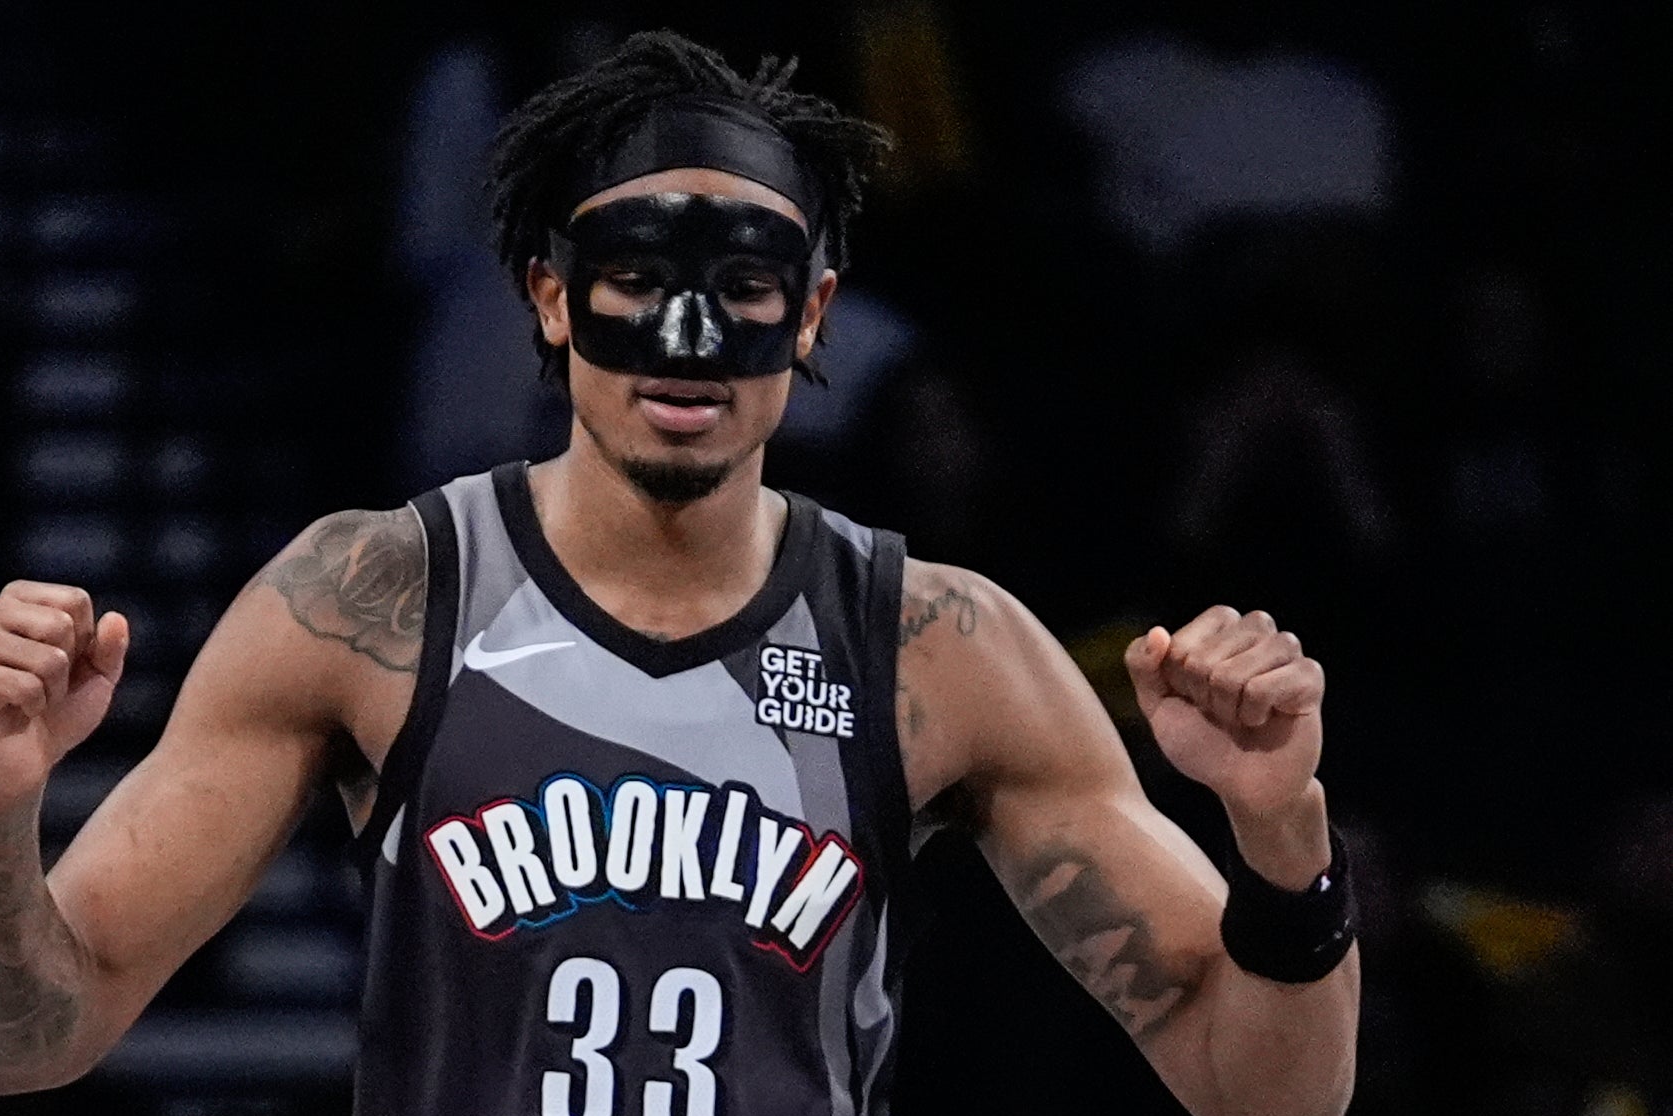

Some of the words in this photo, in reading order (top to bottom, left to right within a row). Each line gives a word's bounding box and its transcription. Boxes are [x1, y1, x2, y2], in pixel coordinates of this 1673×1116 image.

[761, 646, 822, 679] GET
[761, 670, 852, 710] YOUR
[758, 697, 855, 738] GUIDE
[428, 777, 859, 950] BROOKLYN
